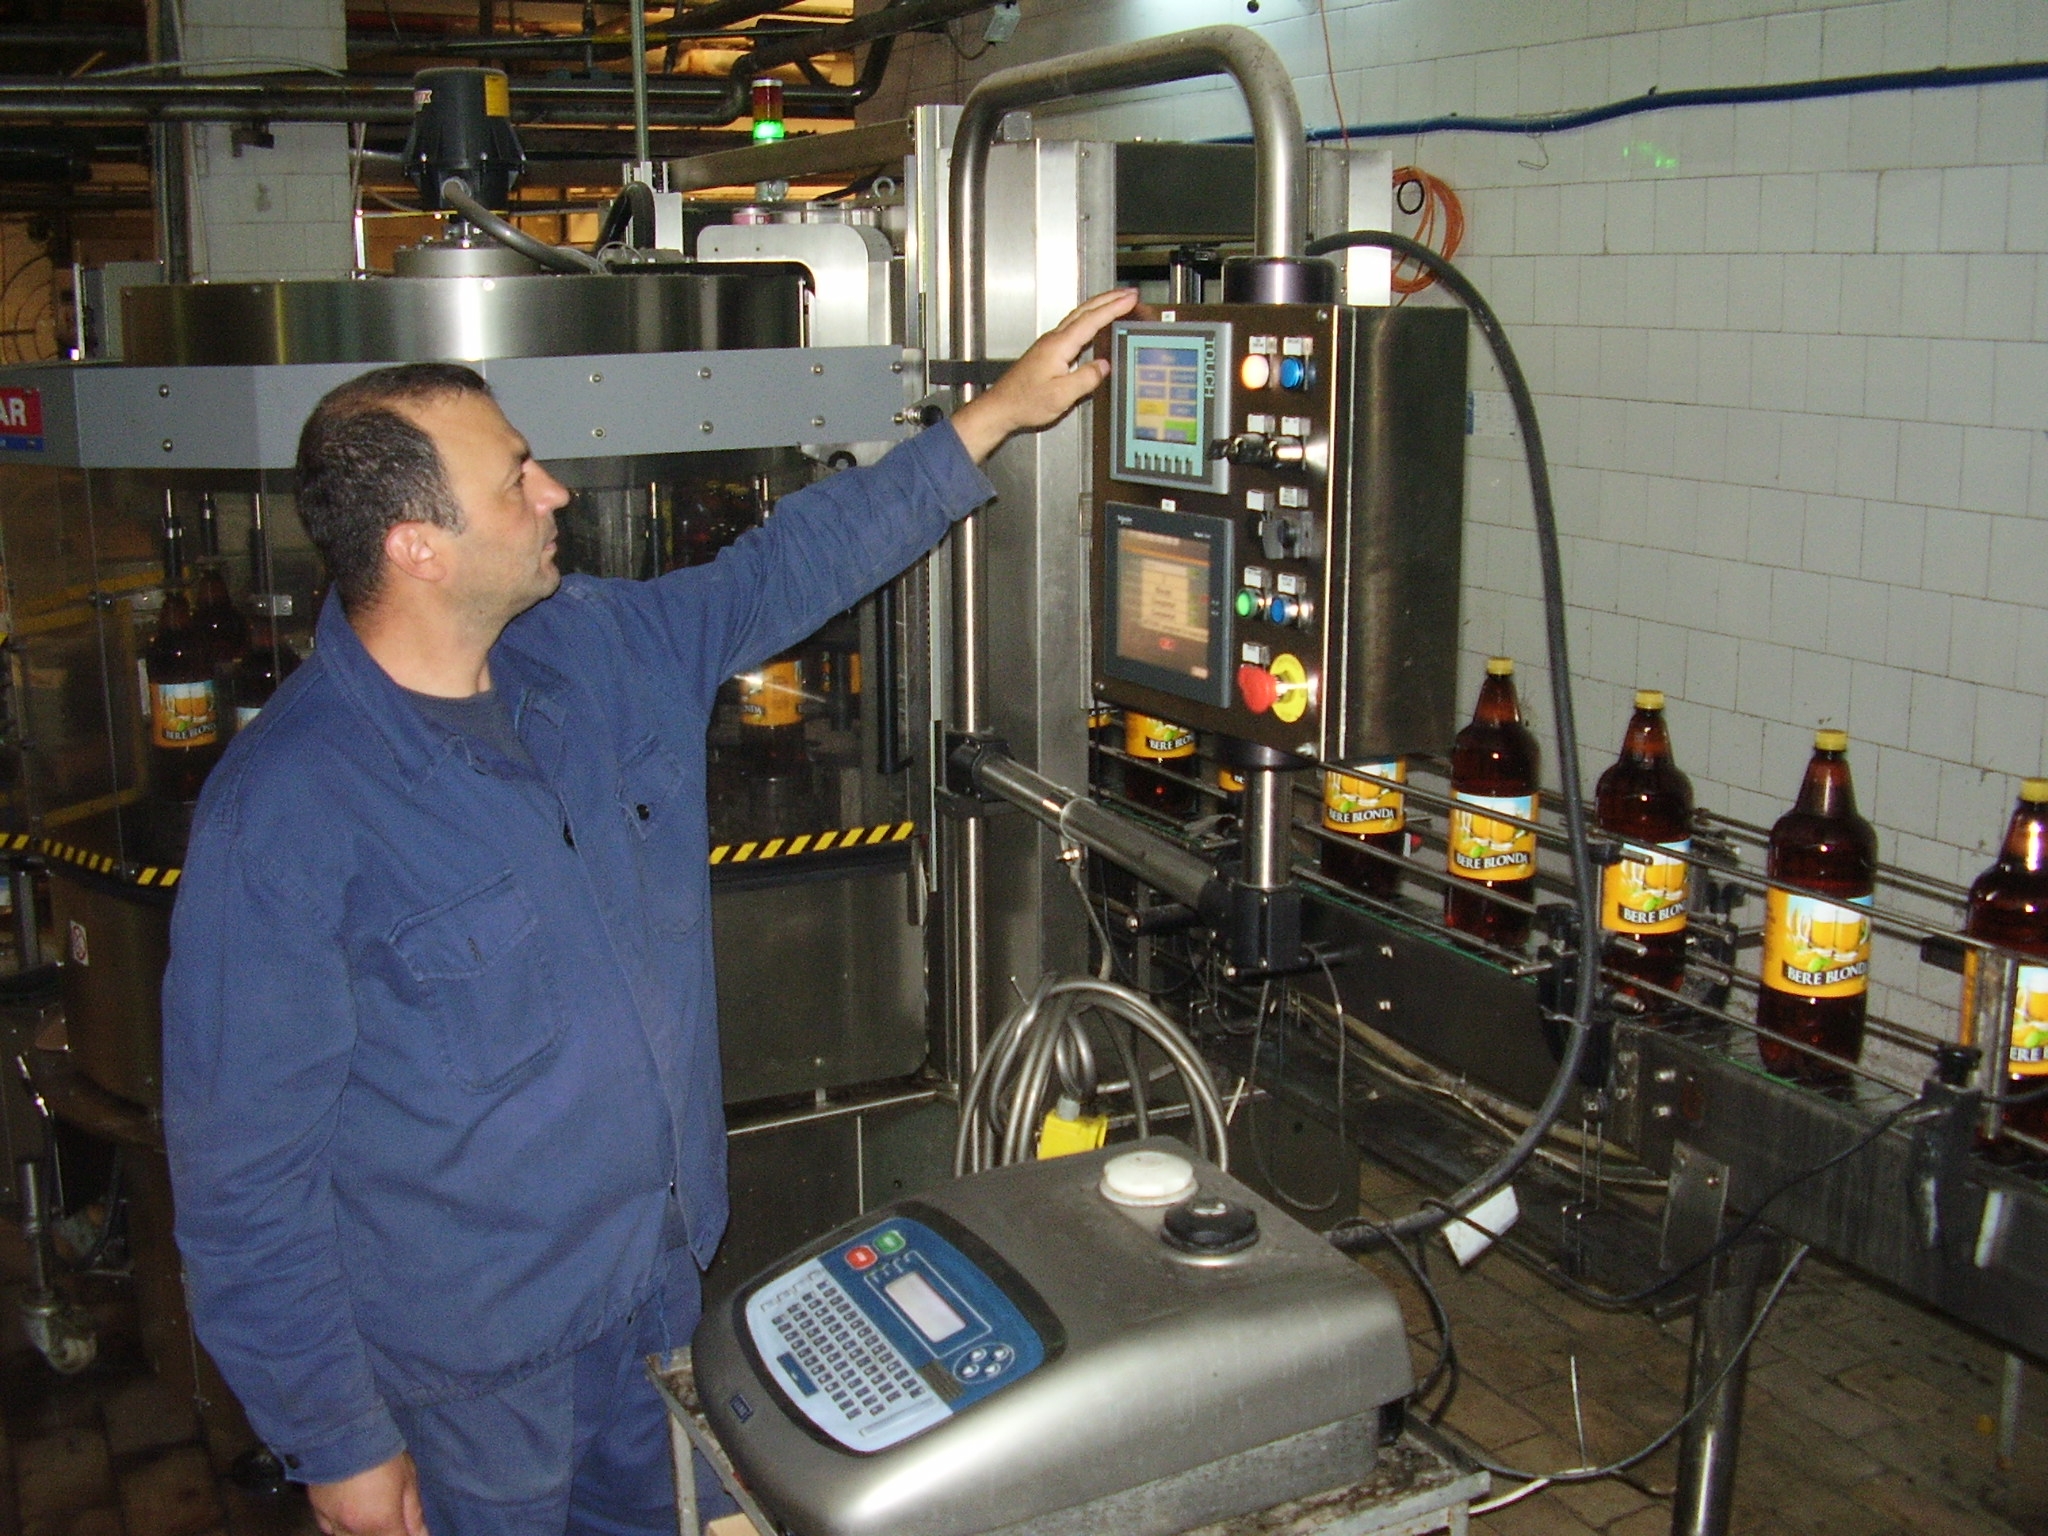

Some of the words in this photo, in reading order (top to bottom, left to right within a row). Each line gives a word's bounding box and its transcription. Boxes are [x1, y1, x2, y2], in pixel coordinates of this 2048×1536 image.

[1204, 337, 1216, 398] TOUCH
[1149, 738, 1174, 751] BERE
[1329, 807, 1350, 824] BERE
[1352, 807, 1395, 823] BLONDA
[1456, 852, 1481, 870] BERE
[1484, 852, 1529, 869] BLONDA
[1623, 906, 1656, 924] BERE
[1786, 965, 1823, 985] BERE
